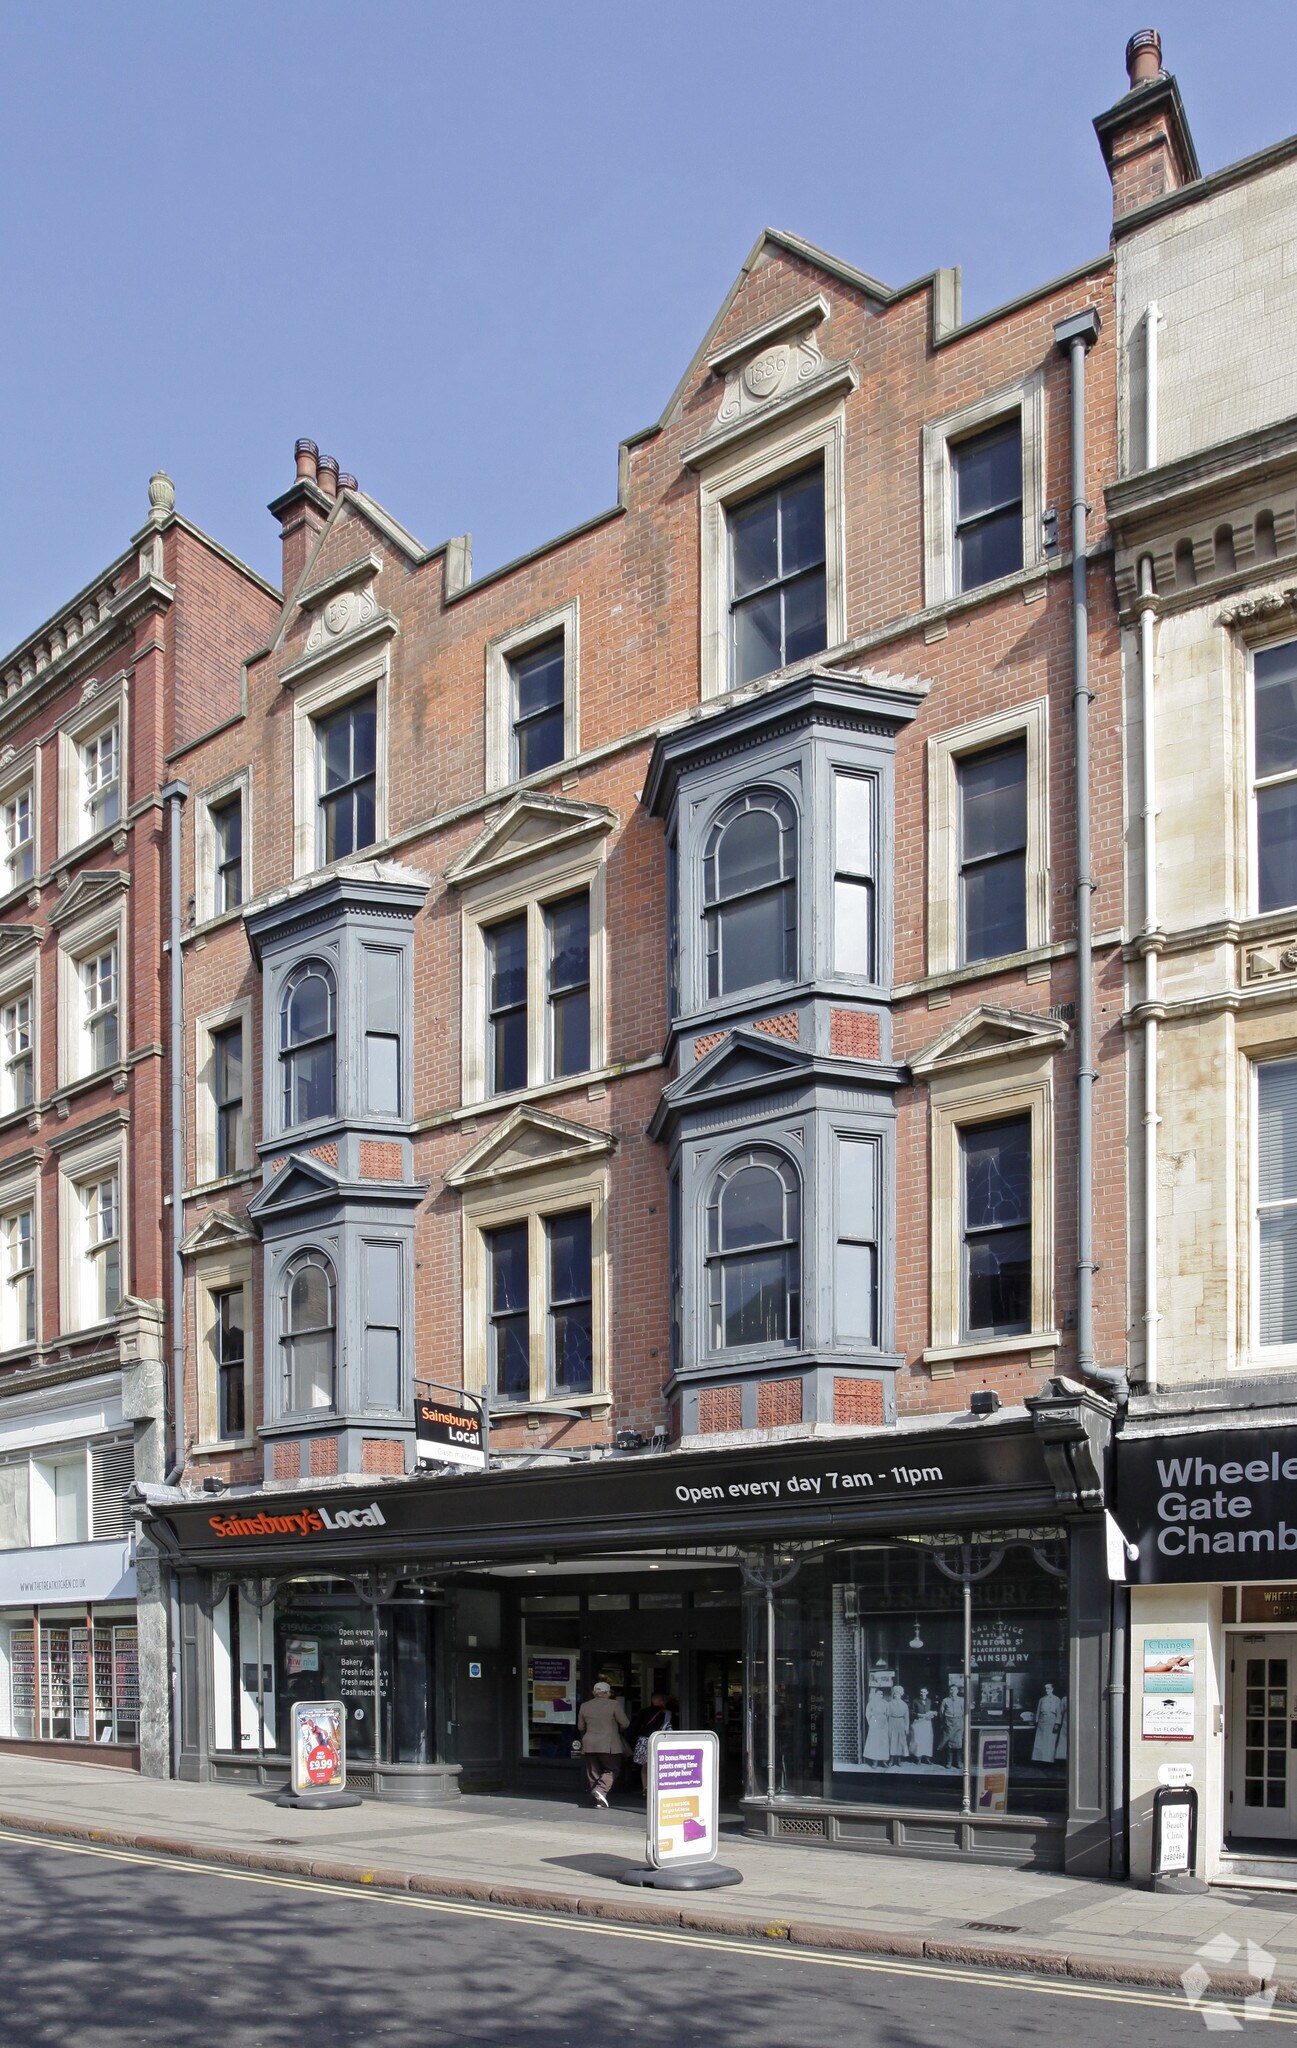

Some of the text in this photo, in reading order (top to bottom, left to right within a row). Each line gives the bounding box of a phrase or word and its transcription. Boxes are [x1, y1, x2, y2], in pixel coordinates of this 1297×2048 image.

[749, 350, 787, 387] 1886
[421, 1406, 479, 1431] Sainsbury's
[448, 1426, 480, 1446] Local
[1156, 1451, 1297, 1488] Wheele
[675, 1485, 725, 1504] Open
[728, 1479, 781, 1497] every
[786, 1475, 822, 1494] day
[825, 1471, 874, 1489] 7am
[890, 1465, 944, 1487] 11pm
[1157, 1490, 1253, 1522] Gate
[208, 1501, 387, 1538] Sainsbury's Local
[1157, 1520, 1297, 1557] Chamb
[338, 1629, 355, 1637] Open
[355, 1629, 374, 1638] every
[340, 1638, 354, 1646] 7am
[1148, 1640, 1192, 1652] Changes
[341, 1658, 363, 1667] Bakery
[341, 1668, 359, 1677] Fresh
[359, 1668, 374, 1677] fruit
[341, 1678, 358, 1687] Fresh
[341, 1688, 387, 1697] Cash machne
[309, 1759, 333, 1771] £9.99
[658, 1763, 674, 1772] points
[658, 1771, 668, 1779] you
[668, 1770, 681, 1778] swipe
[1163, 1810, 1188, 1820] Changes
[1166, 1831, 1184, 1840] Clinic
[1168, 1845, 1181, 1853] 0115
